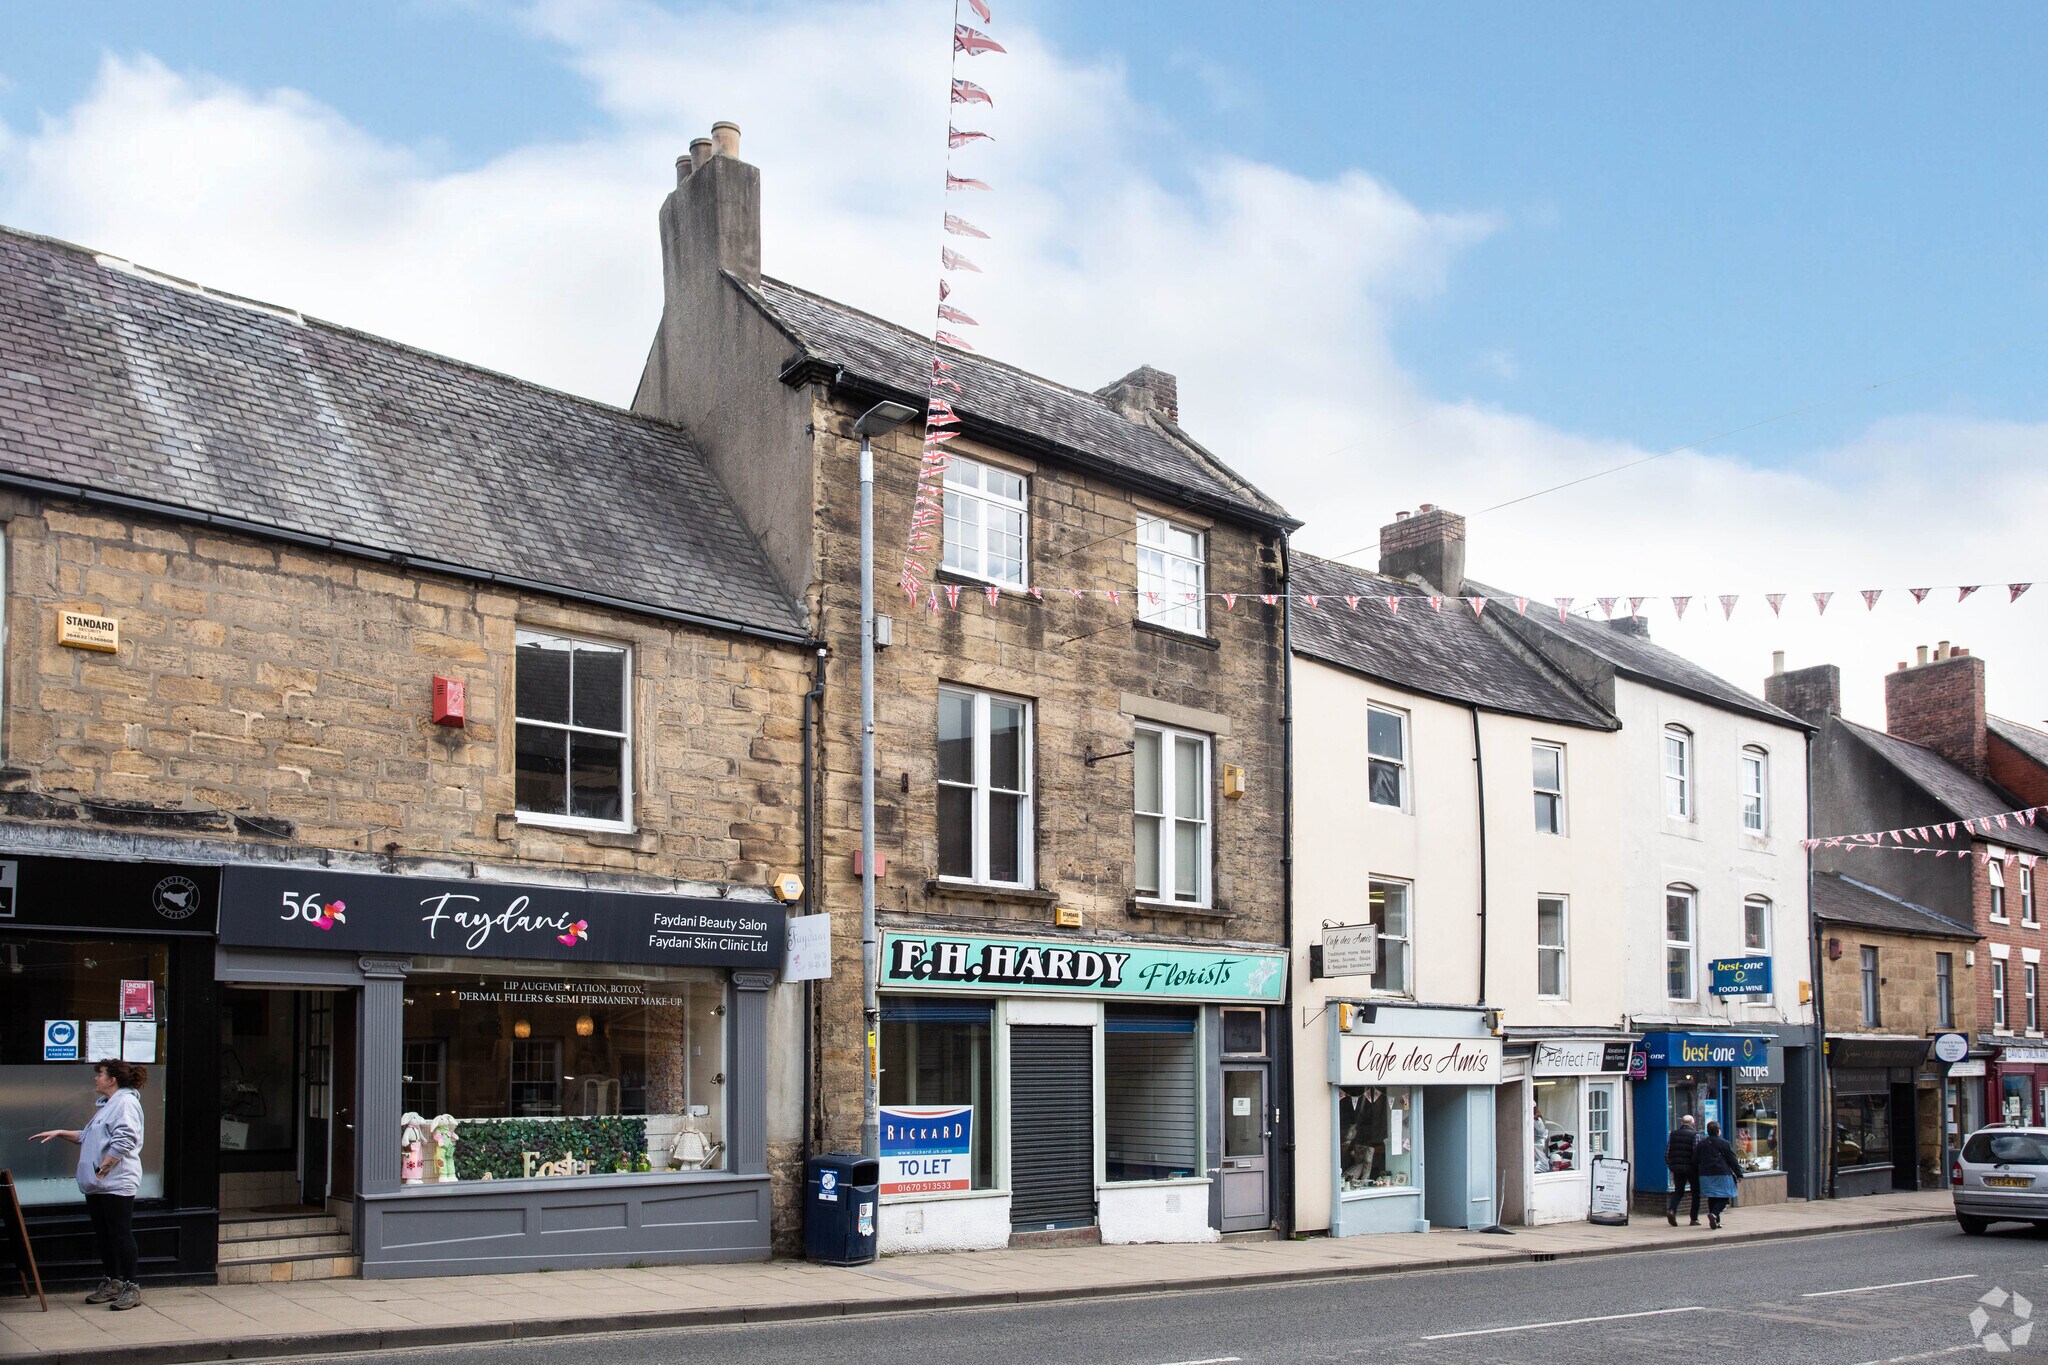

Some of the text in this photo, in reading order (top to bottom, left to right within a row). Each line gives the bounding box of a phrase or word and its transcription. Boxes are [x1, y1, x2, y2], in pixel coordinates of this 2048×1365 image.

[66, 616, 114, 631] STANDARD
[157, 877, 194, 891] SICILIA
[280, 892, 322, 921] 56
[420, 892, 572, 950] Faydani
[654, 913, 767, 931] Faydani Beauty Salon
[649, 935, 768, 952] Faydani Skin Clinic Ltd
[1326, 933, 1371, 949] Cafe des Amis
[1139, 958, 1248, 990] Florists
[1718, 961, 1763, 971] best-one
[504, 981, 644, 994] LIP AUGEMENTATION, BOTOX,
[459, 991, 683, 1006] DERMAL FILLERS & SEMI PERMANENT MAKE-UP
[1548, 1051, 1600, 1067] Perfect Fit
[1682, 1040, 1735, 1062] best-one
[1356, 1040, 1489, 1081] Cafe des Amis
[1740, 1066, 1768, 1081] Stripes
[888, 1123, 962, 1140] RICKARD
[523, 1151, 596, 1178] Easter
[899, 1159, 951, 1175] TO LET
[898, 1182, 951, 1192] 01670 513533
